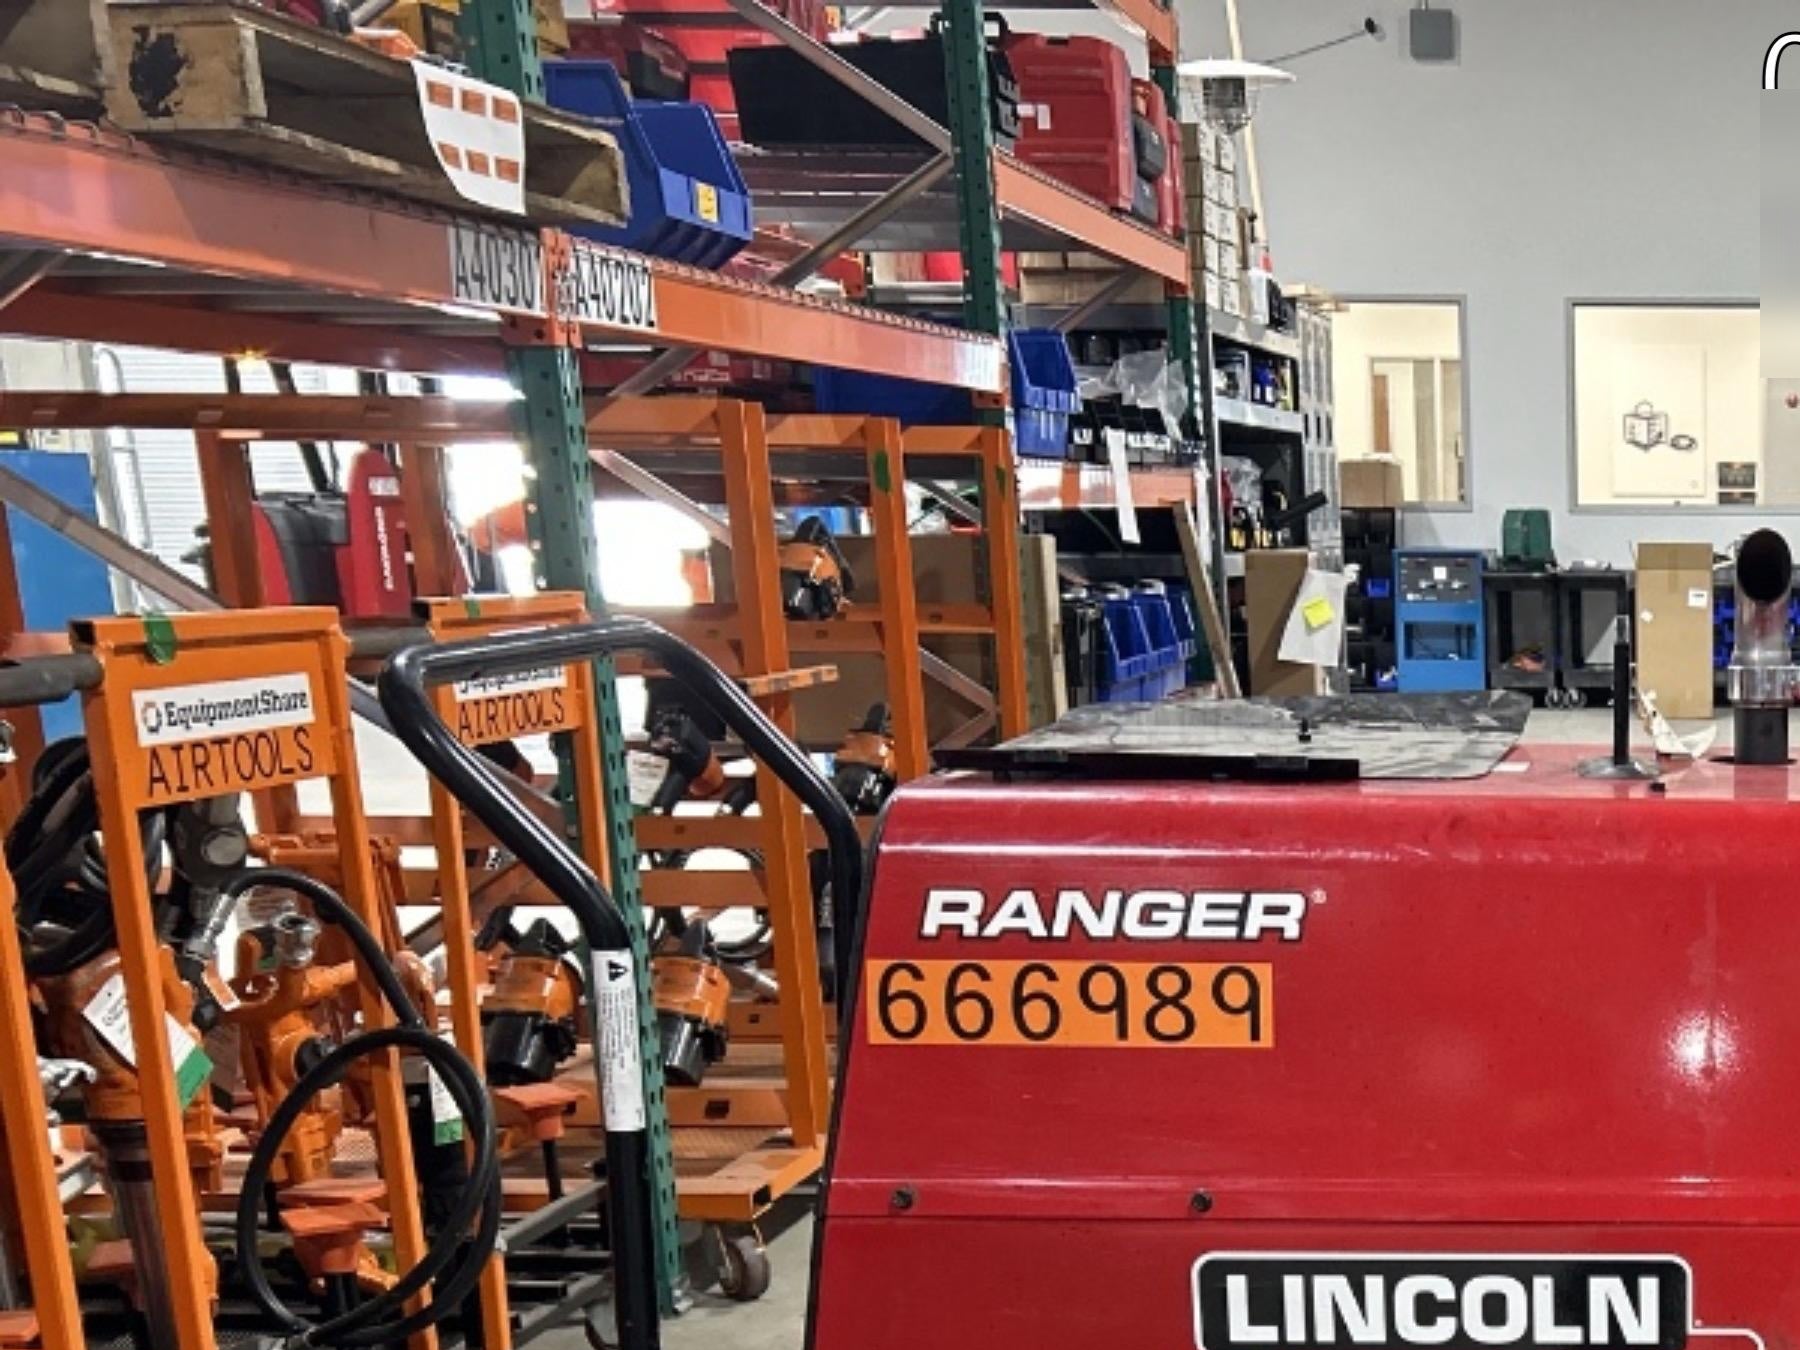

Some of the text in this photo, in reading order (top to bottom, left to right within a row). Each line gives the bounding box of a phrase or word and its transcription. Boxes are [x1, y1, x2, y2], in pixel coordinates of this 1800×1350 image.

[164, 688, 308, 730] EquipmentShare
[460, 686, 564, 741] AIRTOOLS
[149, 725, 313, 798] AIRTOOLS
[877, 961, 1262, 1043] 666989
[1225, 1273, 1661, 1345] LINCOLN
